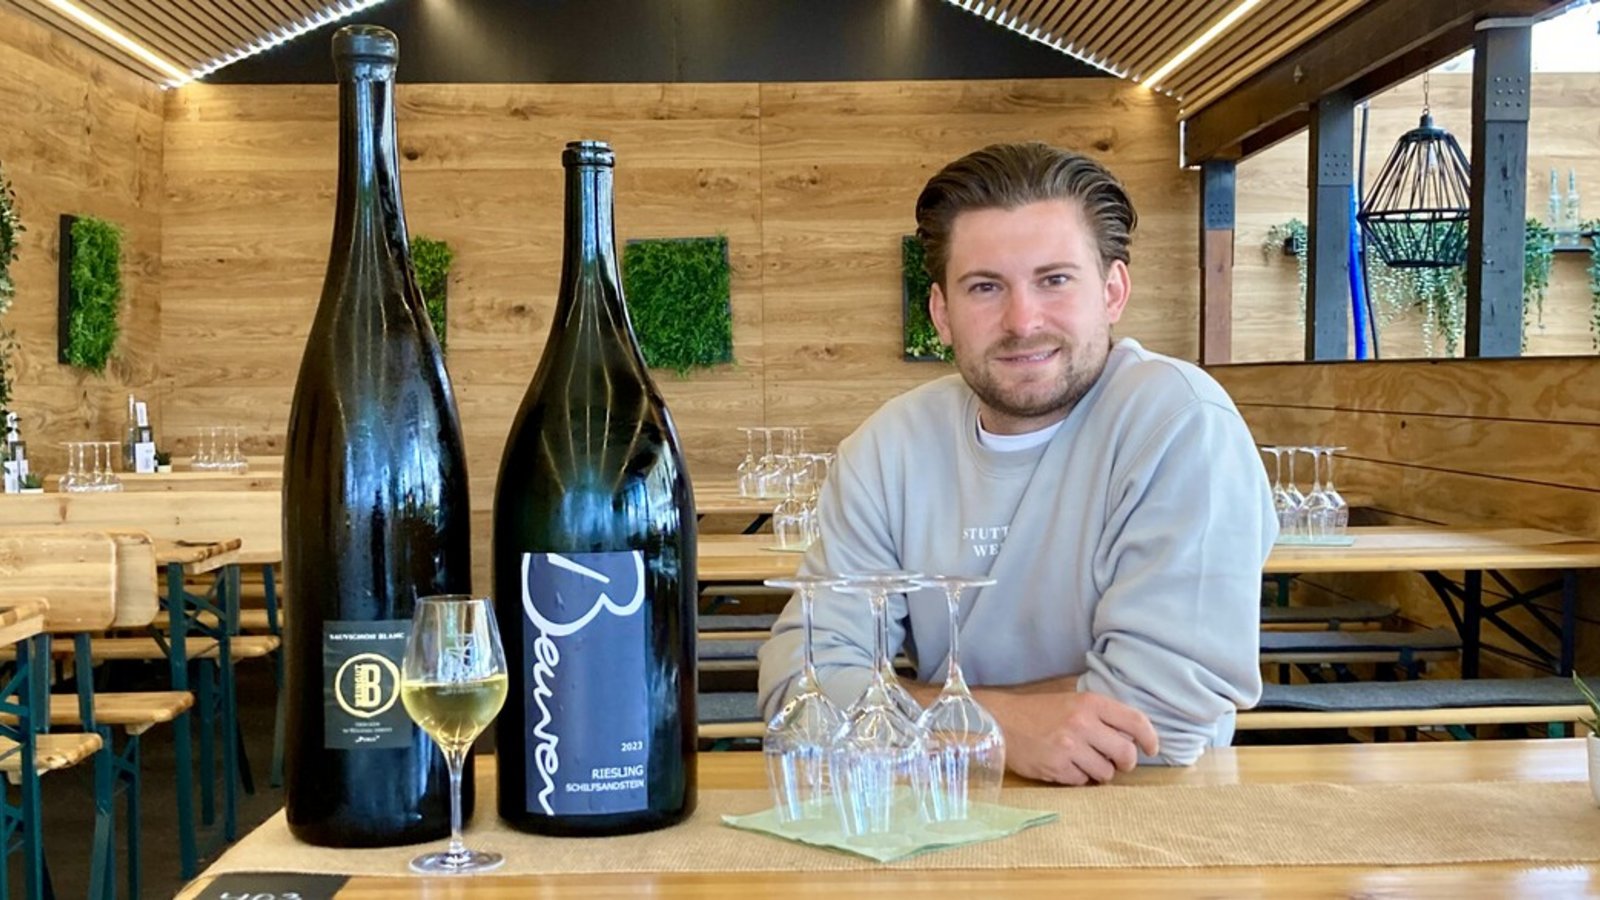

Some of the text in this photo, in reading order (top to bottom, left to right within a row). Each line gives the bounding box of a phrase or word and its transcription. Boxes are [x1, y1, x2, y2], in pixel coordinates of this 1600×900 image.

[378, 632, 405, 640] BLANC
[621, 741, 643, 752] 2023
[592, 765, 644, 779] RIESLING
[565, 779, 645, 792] SCHILFSANDSTEIN
